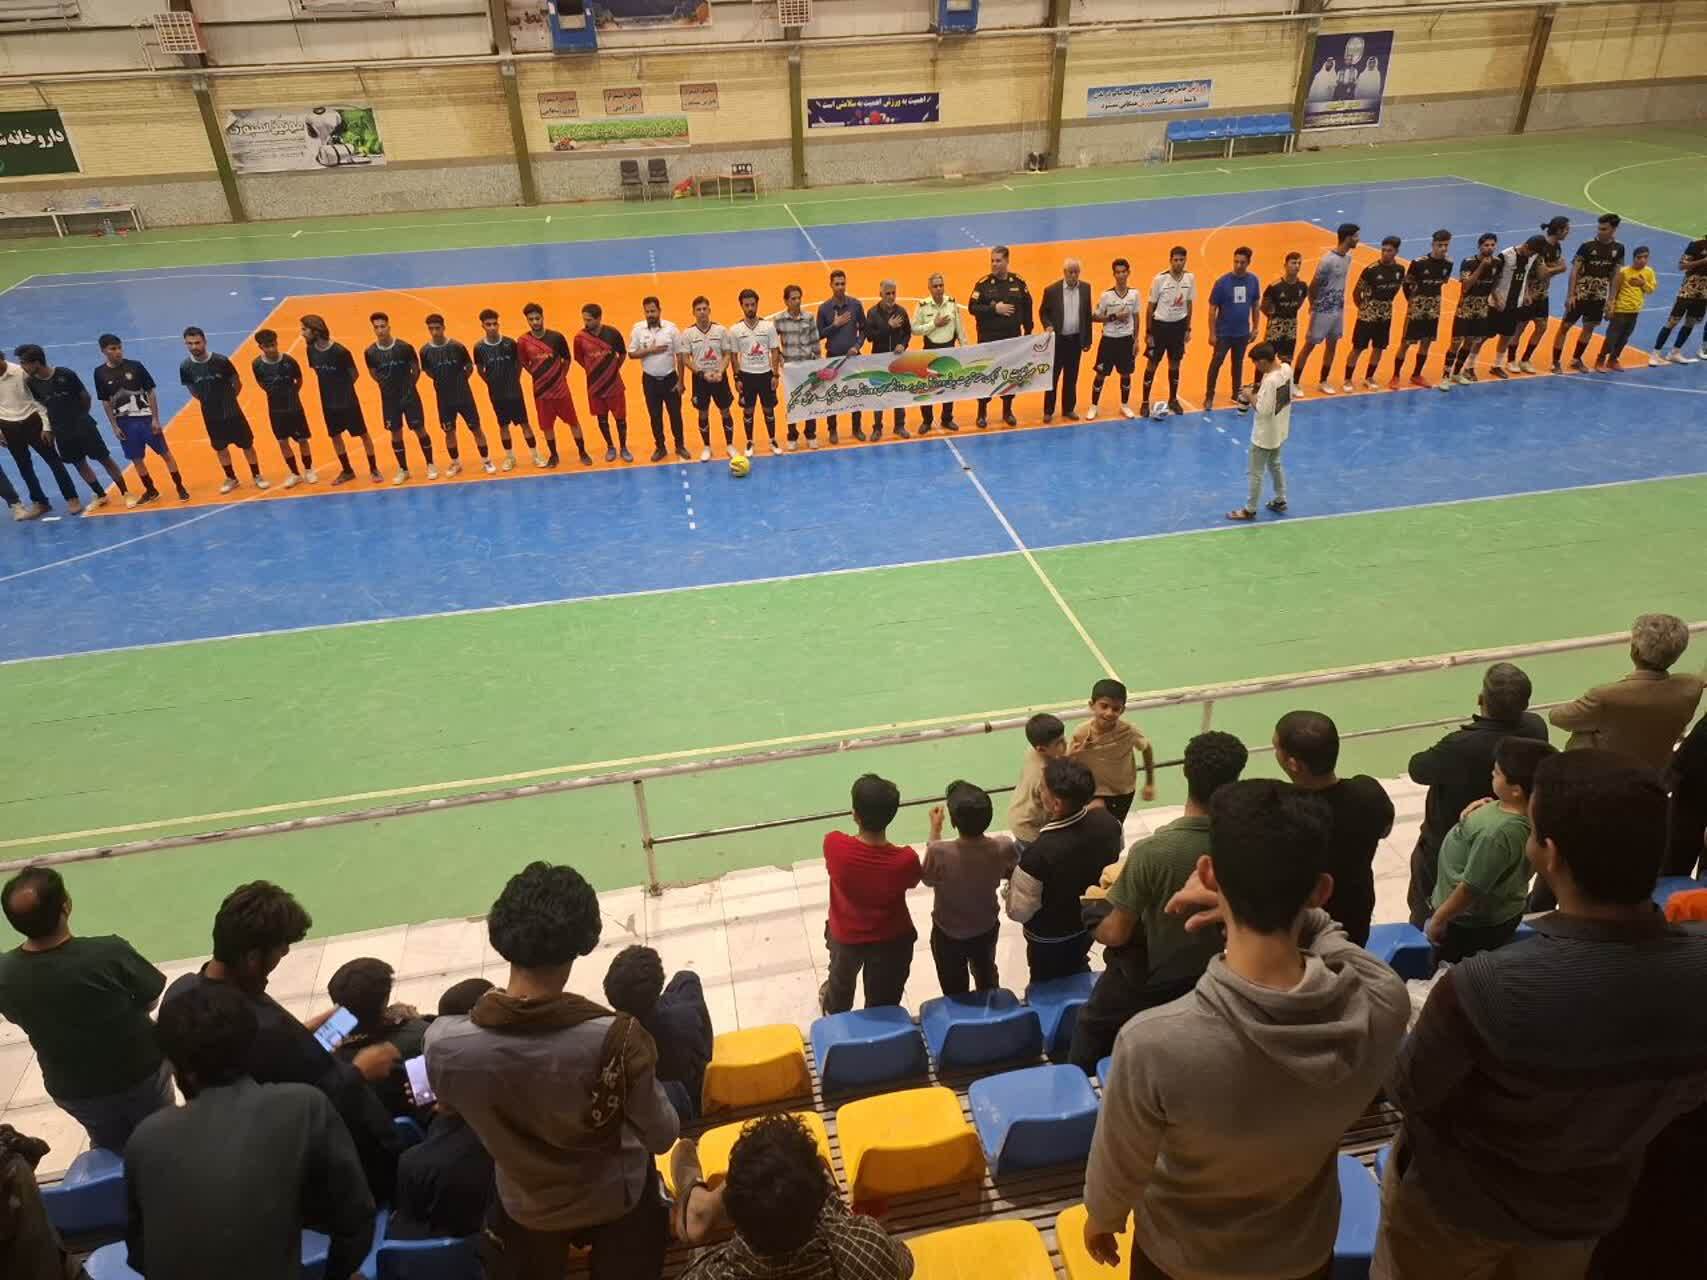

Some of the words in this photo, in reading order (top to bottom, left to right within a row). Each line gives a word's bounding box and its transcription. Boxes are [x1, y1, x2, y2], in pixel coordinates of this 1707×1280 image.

[864, 98, 882, 107] اهمیت
[883, 98, 901, 107] ورزش
[908, 96, 926, 104] اهمیت
[822, 101, 835, 109] است
[7, 127, 65, 148] داروخانه
